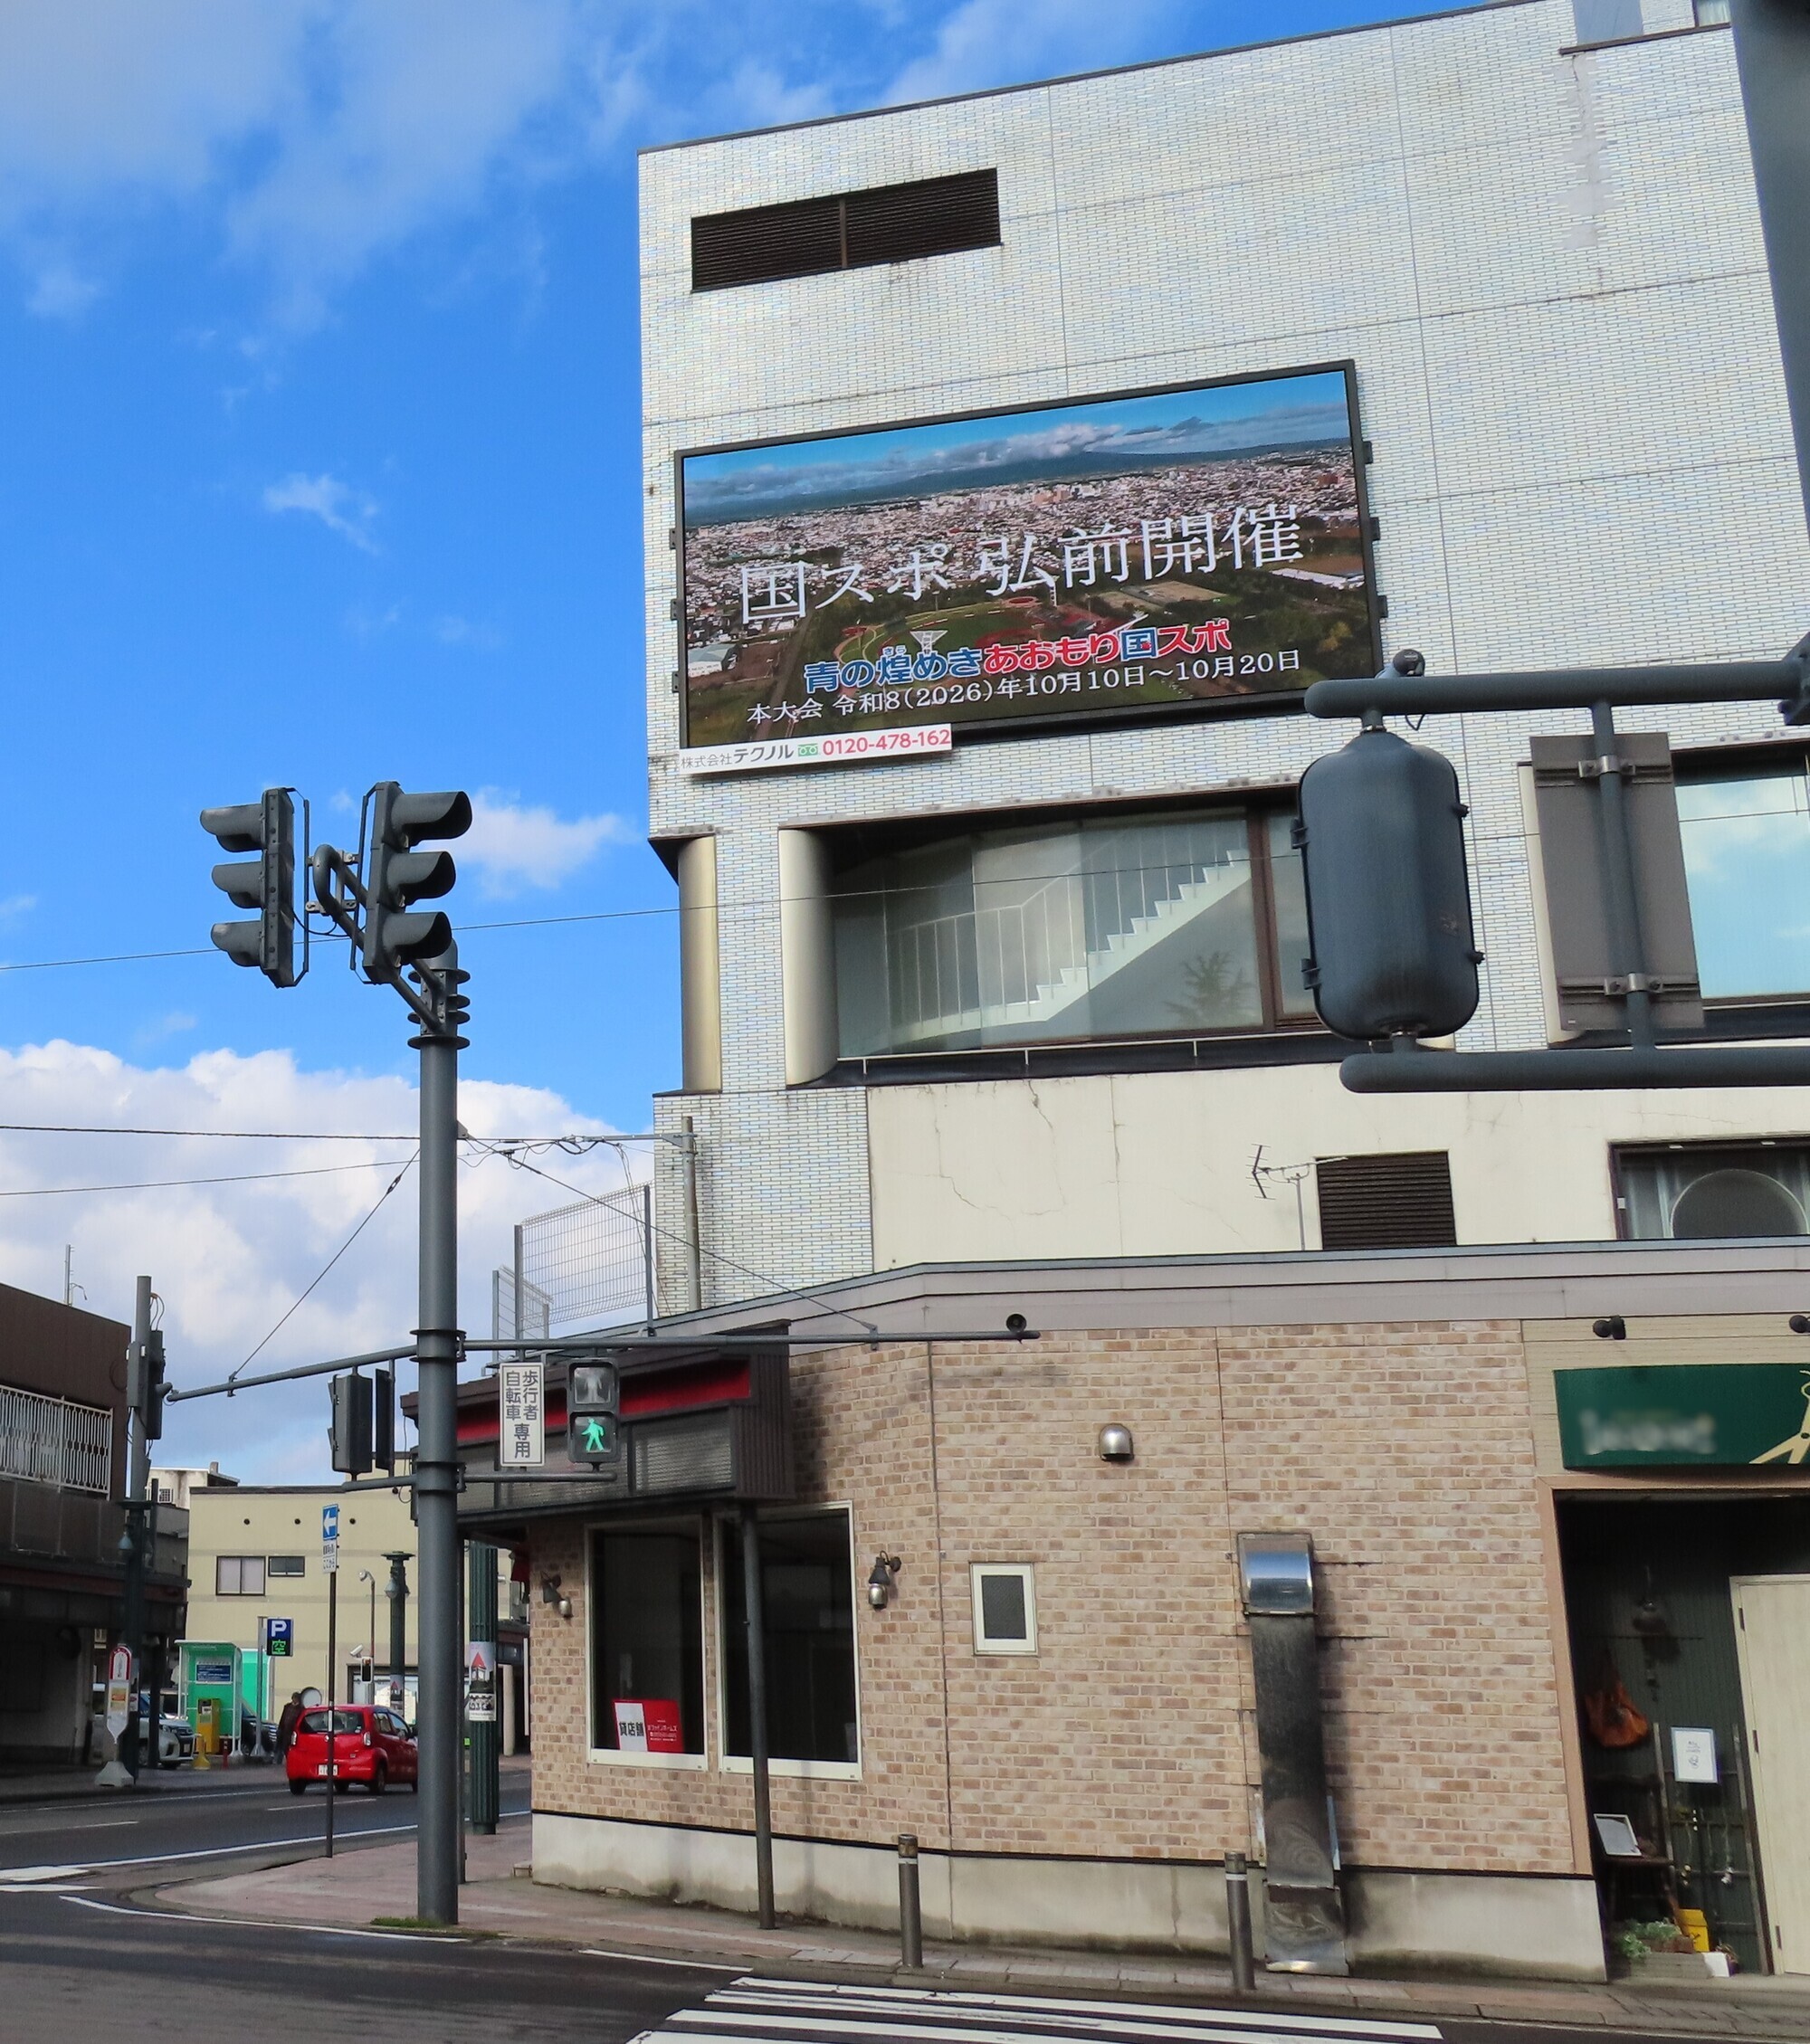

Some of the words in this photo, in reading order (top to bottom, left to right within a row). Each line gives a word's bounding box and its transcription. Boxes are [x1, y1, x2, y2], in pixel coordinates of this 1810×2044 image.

[741, 545, 950, 624] 国スポ
[977, 503, 1303, 596] 弘前開催
[747, 697, 824, 725] 本大会
[823, 728, 951, 756] 0120-478-162
[506, 1371, 521, 1421] 自転車
[522, 1370, 538, 1421] 歩行者
[514, 1423, 530, 1459] 専用
[272, 1621, 287, 1637] P
[272, 1639, 286, 1655] 空
